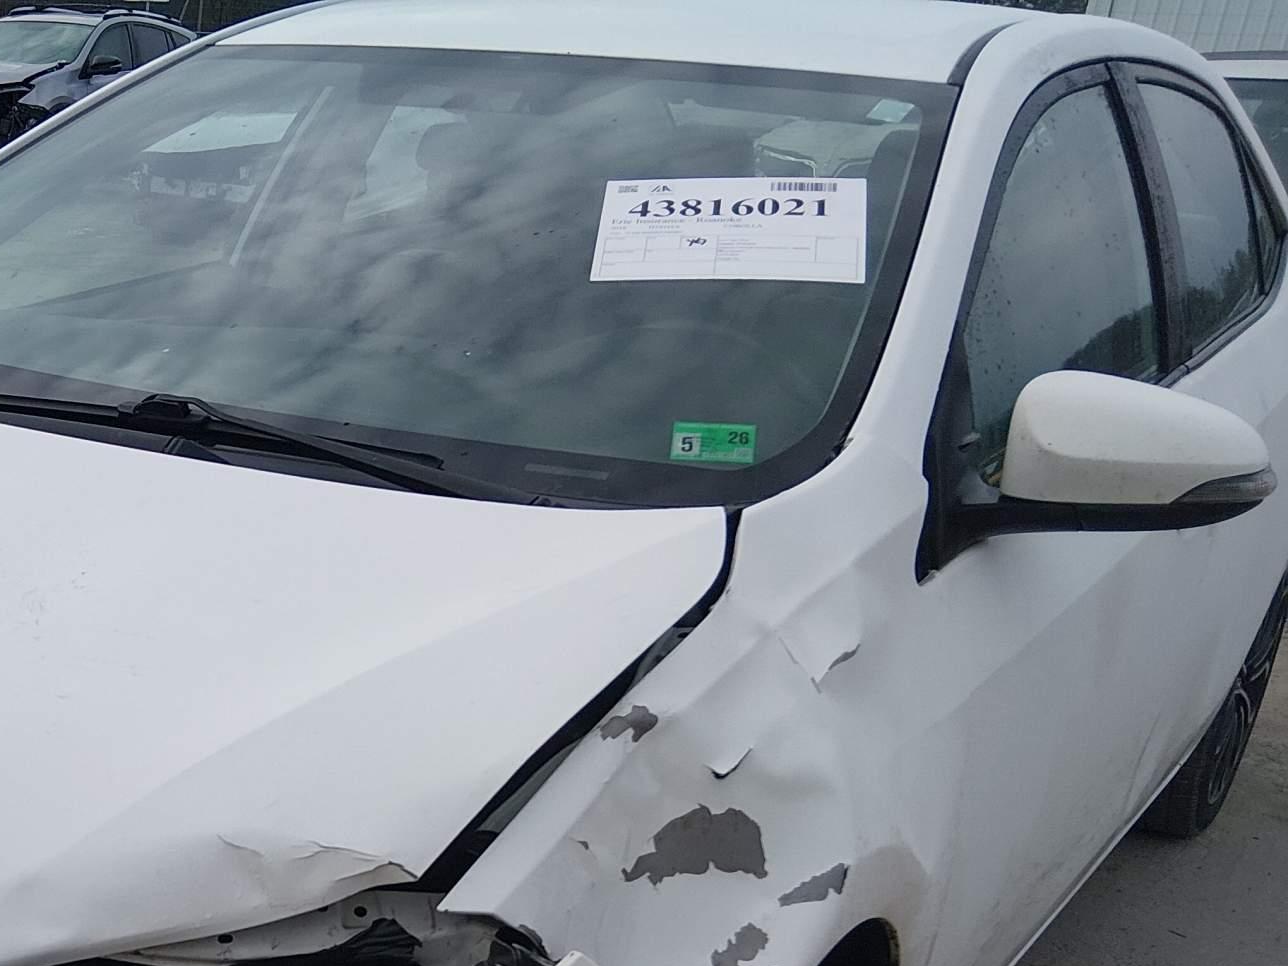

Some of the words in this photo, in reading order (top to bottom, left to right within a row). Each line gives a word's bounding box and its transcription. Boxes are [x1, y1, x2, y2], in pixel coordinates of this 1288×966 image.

[628, 198, 828, 217] 43816021
[681, 436, 694, 453] 5
[727, 431, 750, 445] 26
